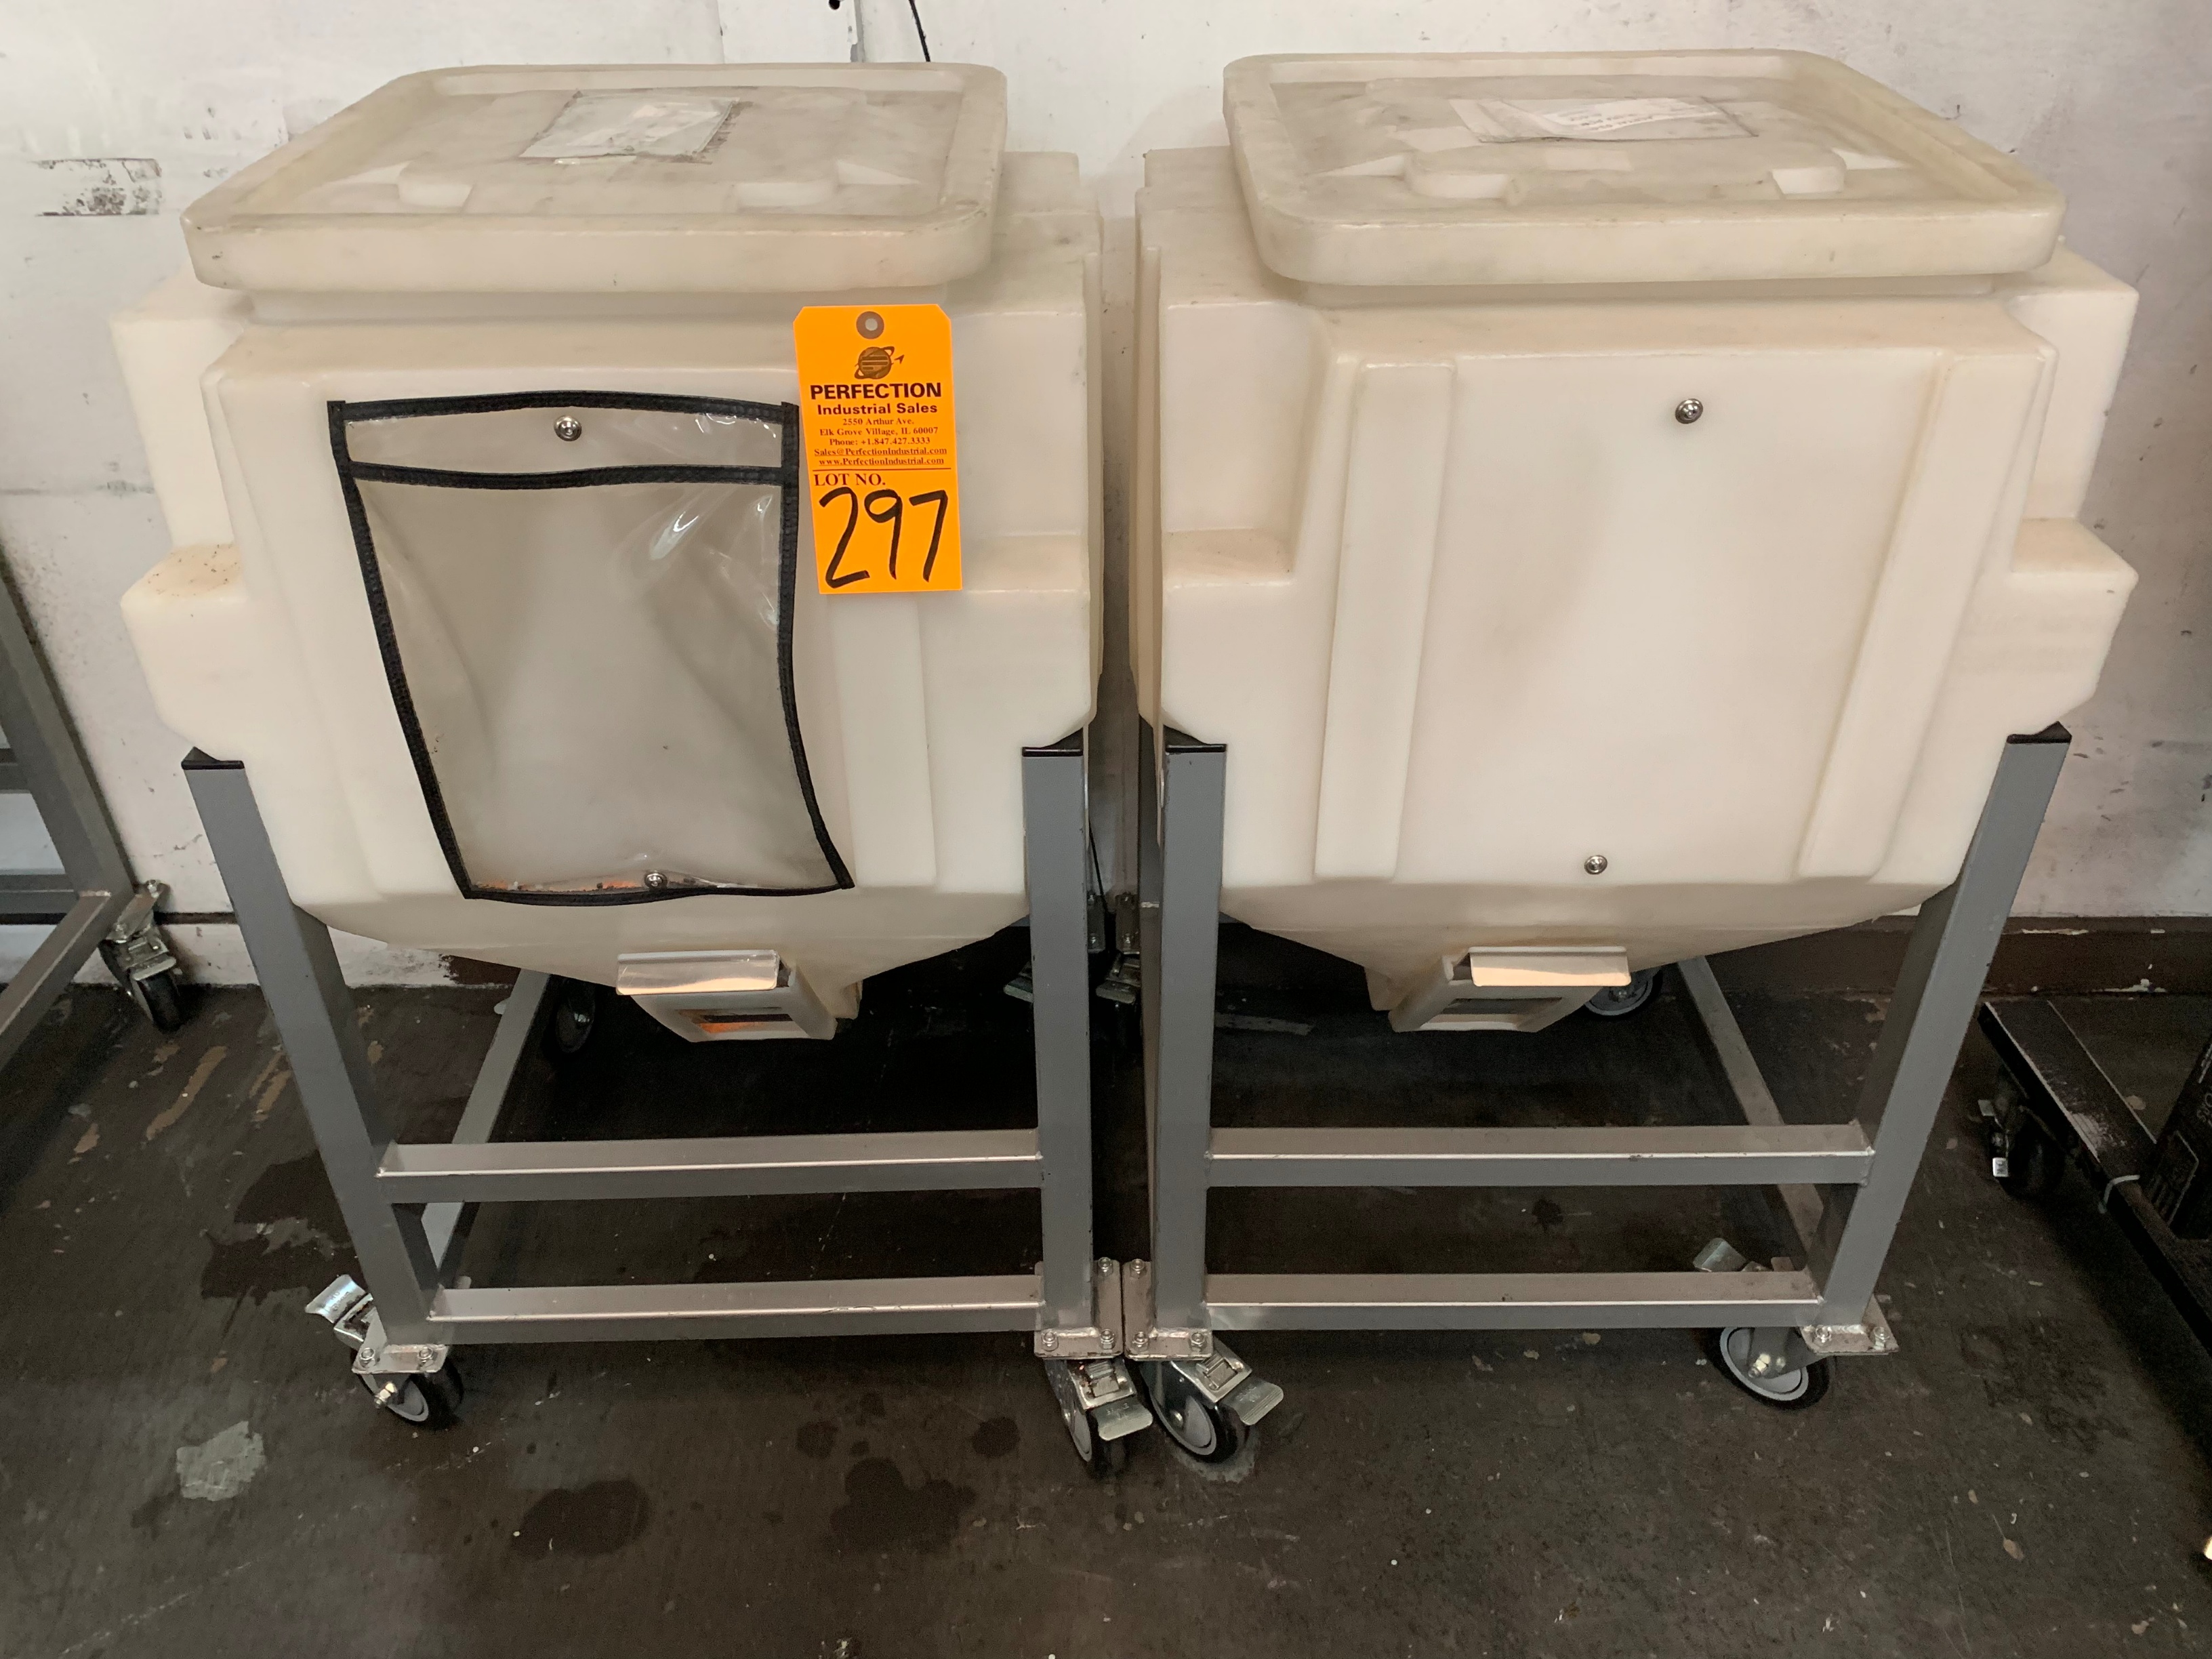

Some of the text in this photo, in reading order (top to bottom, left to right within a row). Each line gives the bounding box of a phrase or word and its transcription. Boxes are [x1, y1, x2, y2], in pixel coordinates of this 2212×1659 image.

[810, 382, 941, 400] PERFECTION
[817, 403, 938, 415] Industrial Sales
[865, 417, 894, 426] Arthur
[865, 427, 899, 437] Village,
[913, 426, 939, 434] 60007
[861, 436, 930, 445] +1.847.427.3333
[814, 447, 947, 456] Sales@PerfectionIndustrial.com
[819, 457, 945, 466] www.PerfectionIndustrial.com
[814, 472, 886, 486] LOT NO.
[819, 487, 949, 589] 297
